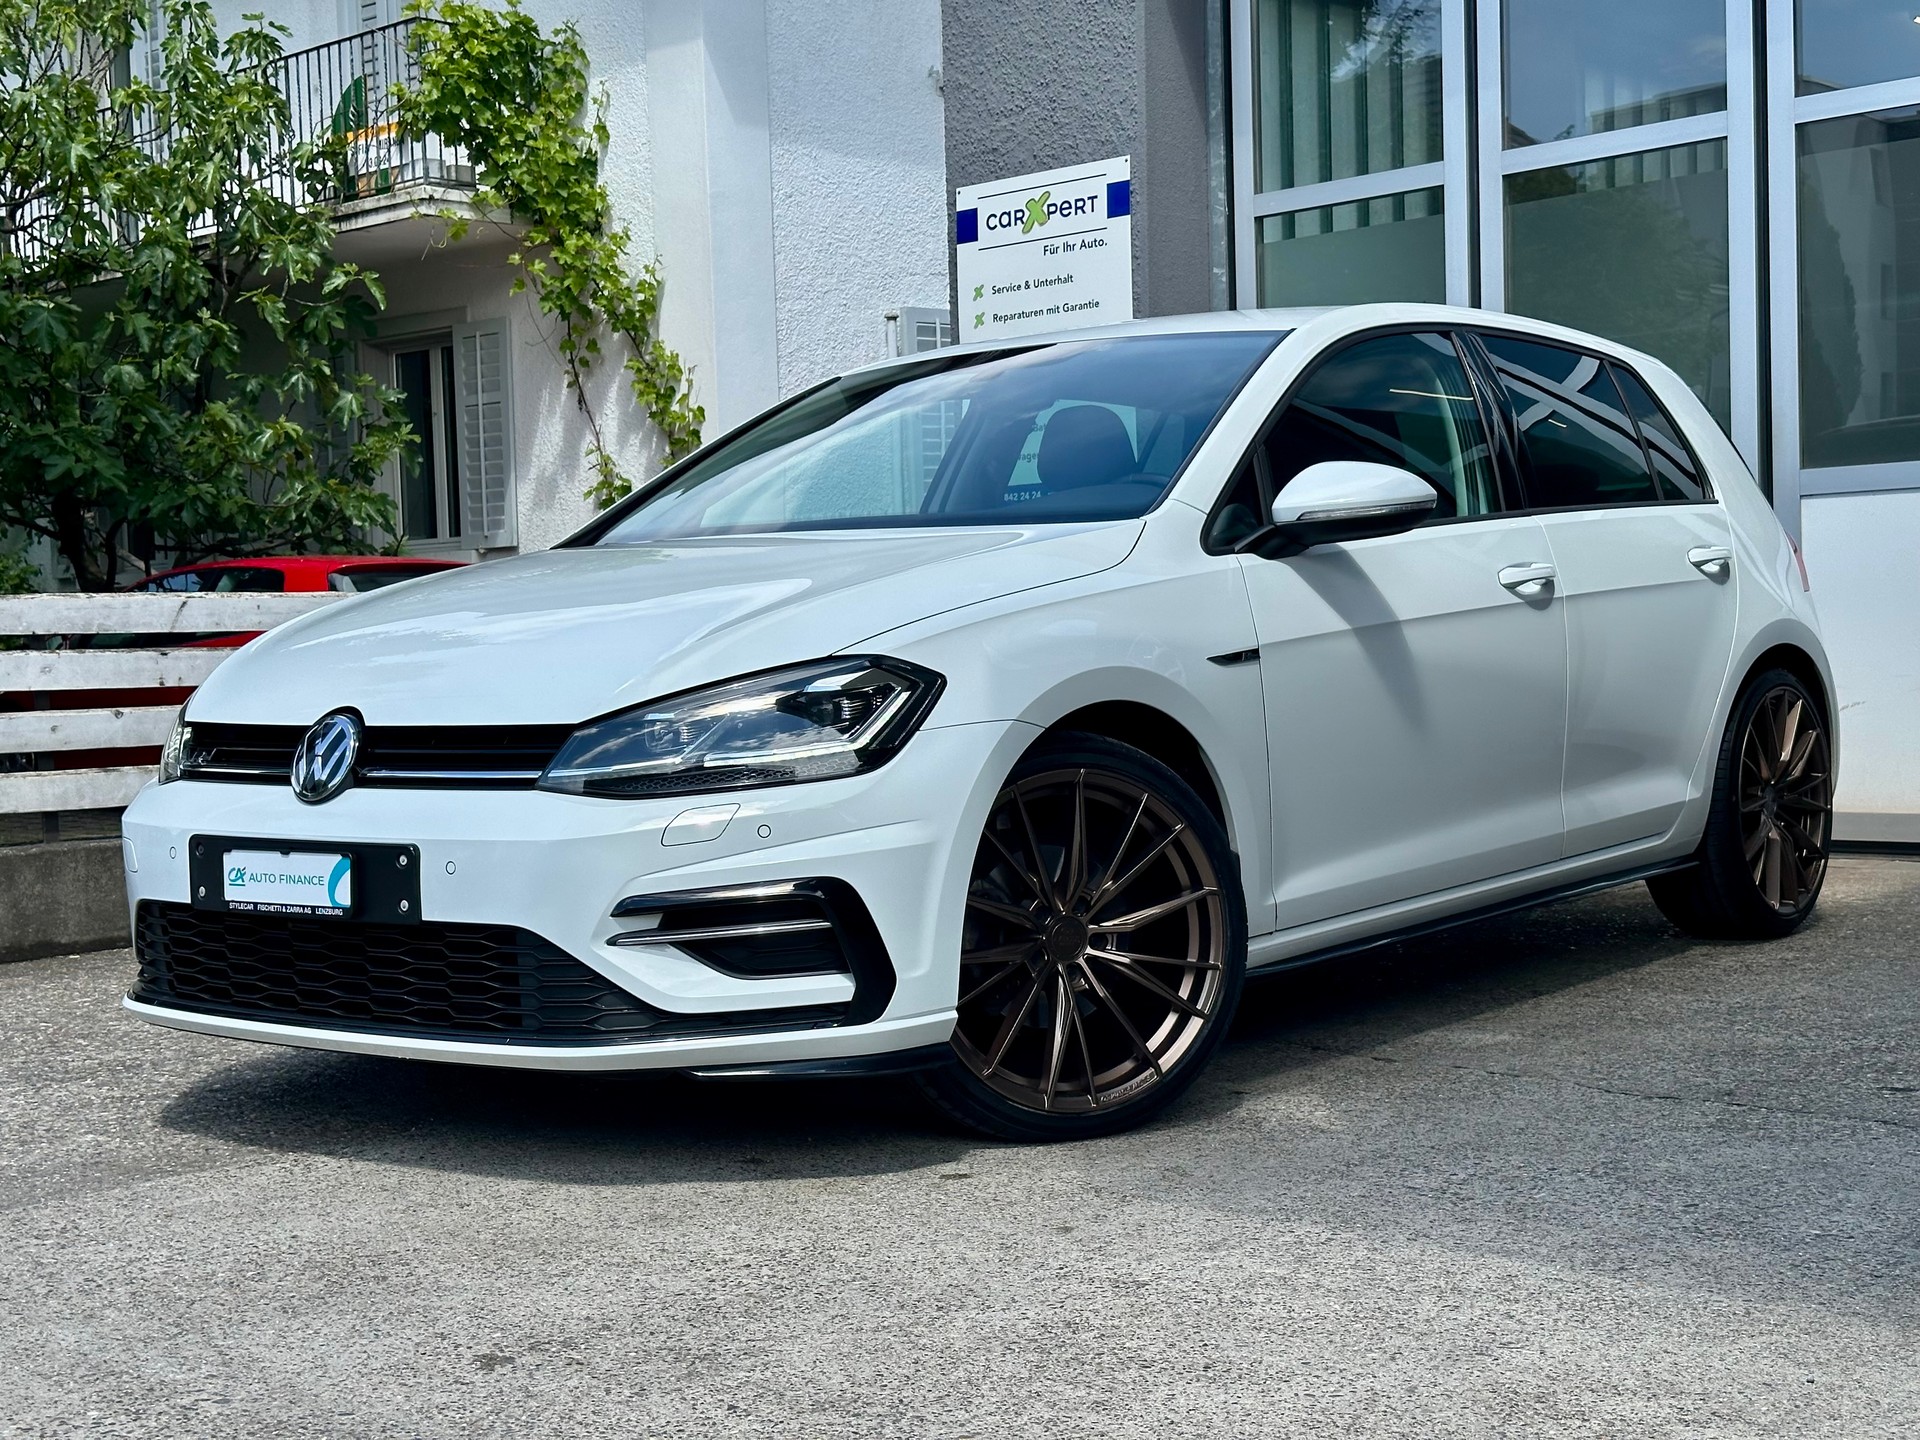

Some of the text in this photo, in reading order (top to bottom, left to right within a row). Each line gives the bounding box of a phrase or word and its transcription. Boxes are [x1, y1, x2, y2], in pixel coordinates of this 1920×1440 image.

[1043, 238, 1108, 256] Für Ihr Auto.
[992, 273, 1074, 295] Service & Unterhalt
[992, 299, 1100, 324] Reparaturen mit Garantie
[249, 872, 277, 884] AUTO
[279, 874, 325, 886] FINANCE
[229, 902, 254, 911] STYLECAR
[257, 904, 282, 912] FISCHETTI
[304, 906, 311, 914] AG
[315, 908, 343, 916] LENZBURG
